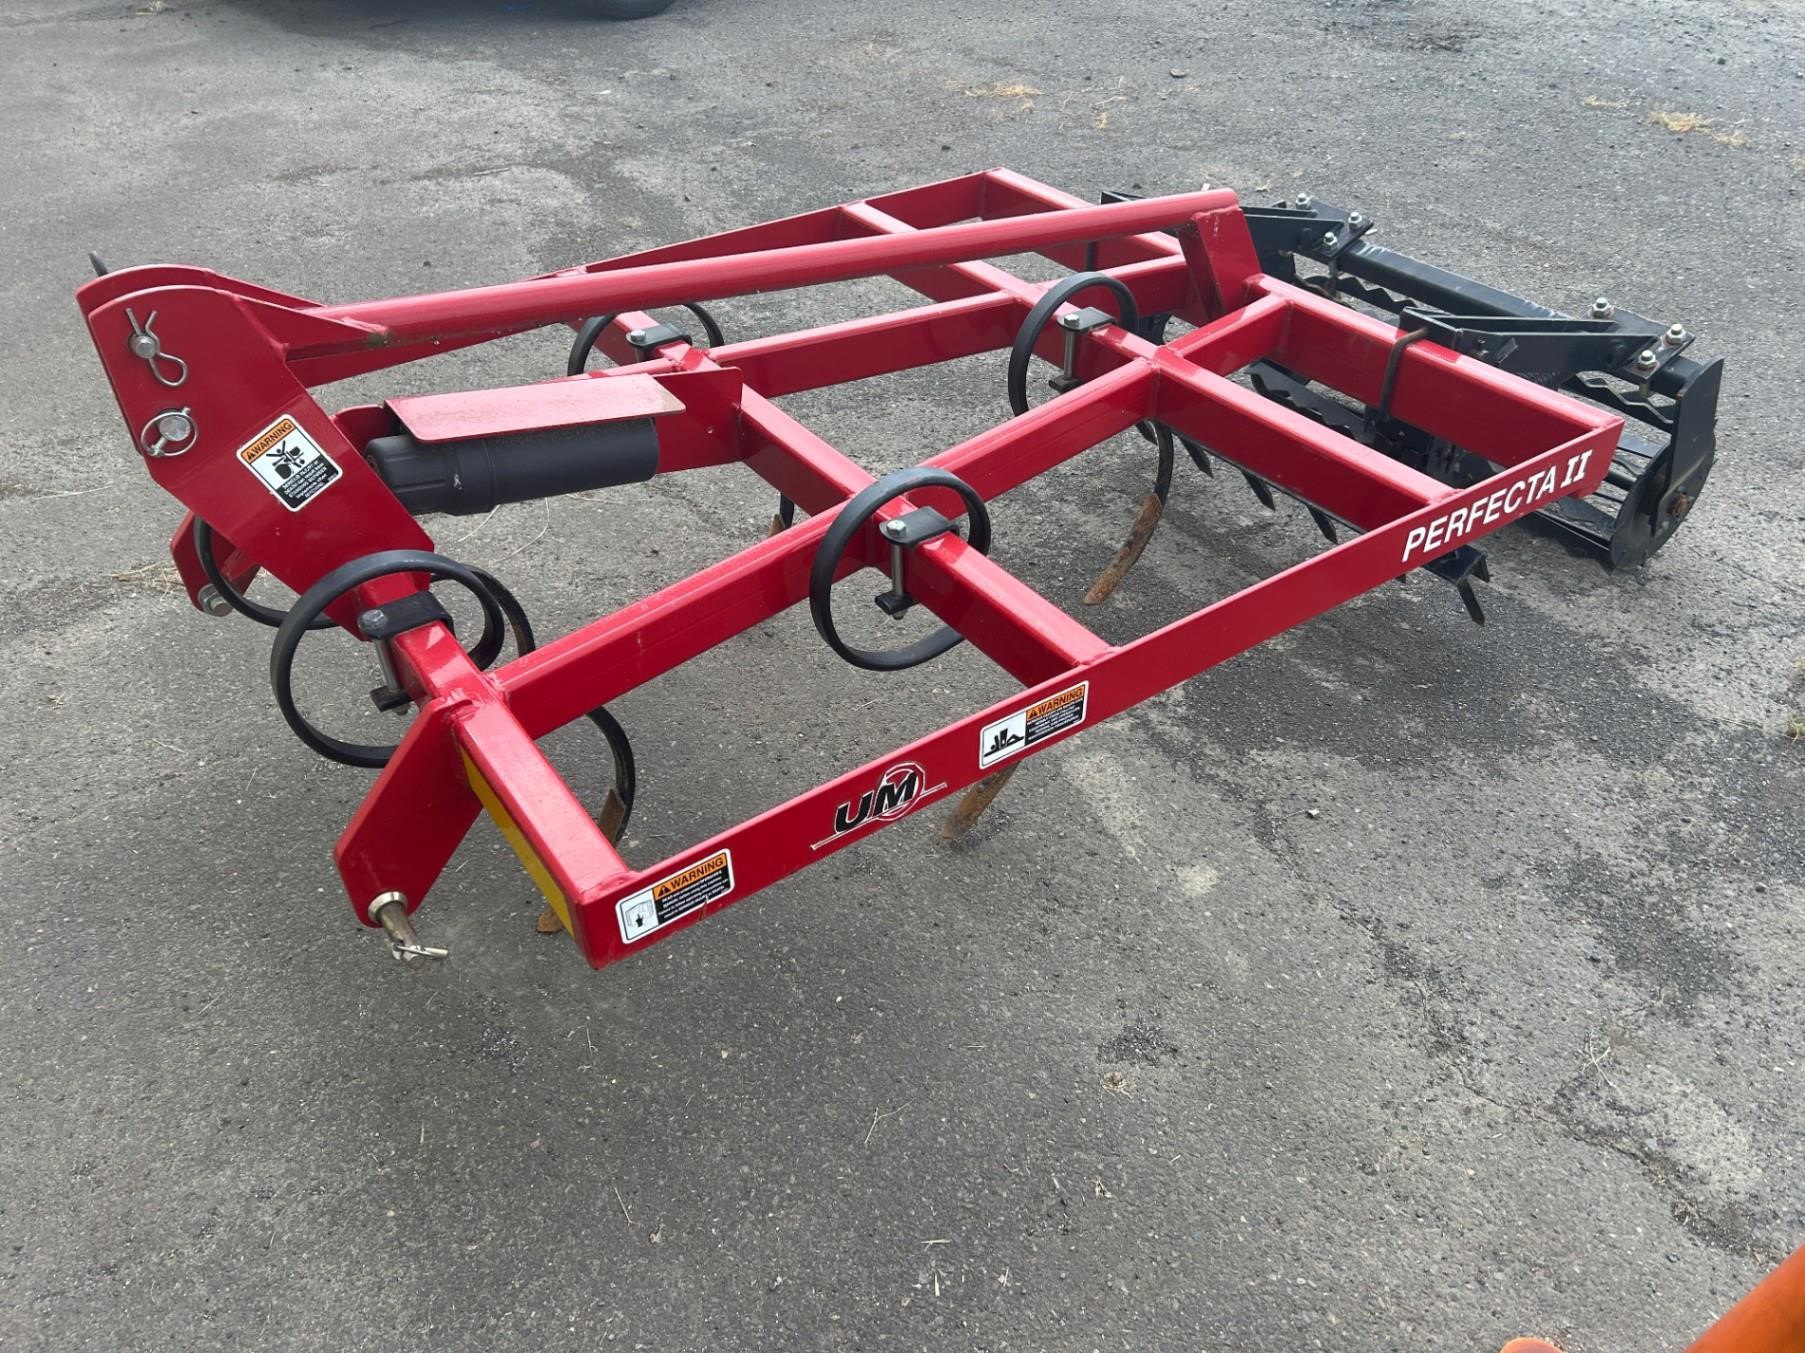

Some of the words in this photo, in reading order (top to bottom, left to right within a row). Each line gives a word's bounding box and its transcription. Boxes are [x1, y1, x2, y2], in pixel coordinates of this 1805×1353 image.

[251, 422, 292, 455] WARNING
[1402, 465, 1557, 563] PERFECTA
[1560, 449, 1593, 488] II
[1039, 687, 1083, 715] WARNING
[834, 769, 919, 834] UM
[671, 857, 724, 890] WARNING
